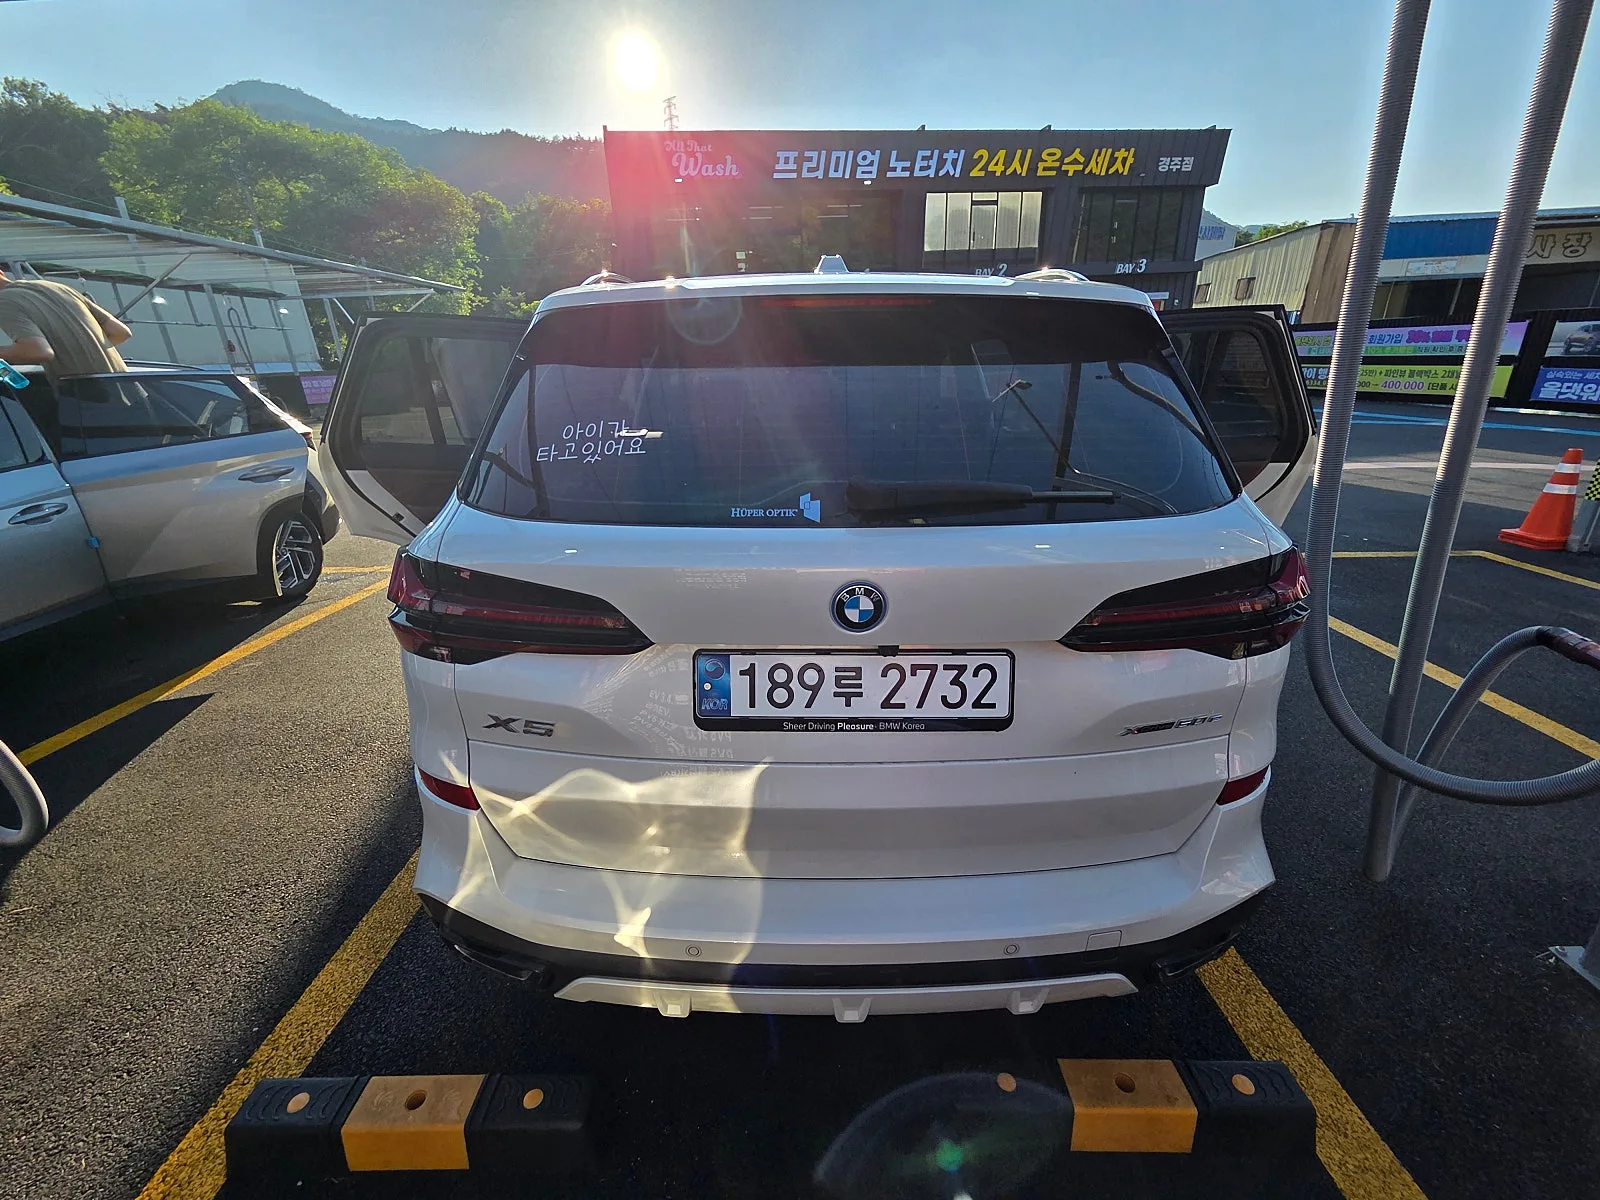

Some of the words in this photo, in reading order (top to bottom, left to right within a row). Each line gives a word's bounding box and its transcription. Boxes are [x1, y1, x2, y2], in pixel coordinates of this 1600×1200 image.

[664, 140, 684, 152] All
[687, 140, 713, 152] That
[672, 152, 739, 177] Wash
[773, 149, 881, 179] 프리미엄
[886, 149, 966, 178] 노터치
[969, 148, 1032, 176] 24시
[1036, 147, 1135, 176] 온수세차
[1158, 156, 1195, 172] 경주점
[975, 267, 993, 277] BAY
[1115, 263, 1135, 274] BAY
[1137, 258, 1147, 273] 3
[1368, 333, 1403, 345] 회원가입
[1408, 369, 1439, 379] 블랙박스
[1539, 381, 1600, 401] 올댓워
[730, 507, 765, 517] HÜPER
[766, 508, 798, 517] OPTIK
[840, 587, 880, 602] BMW
[739, 662, 863, 709] 189루
[880, 662, 998, 709] 2732
[701, 697, 729, 710] KOR
[482, 713, 555, 738] X5
[783, 721, 807, 730] Sheer
[808, 721, 835, 732] Driving
[838, 721, 874, 730] Pleasure
[879, 721, 901, 730] BMW
[902, 721, 925, 730] Korea
